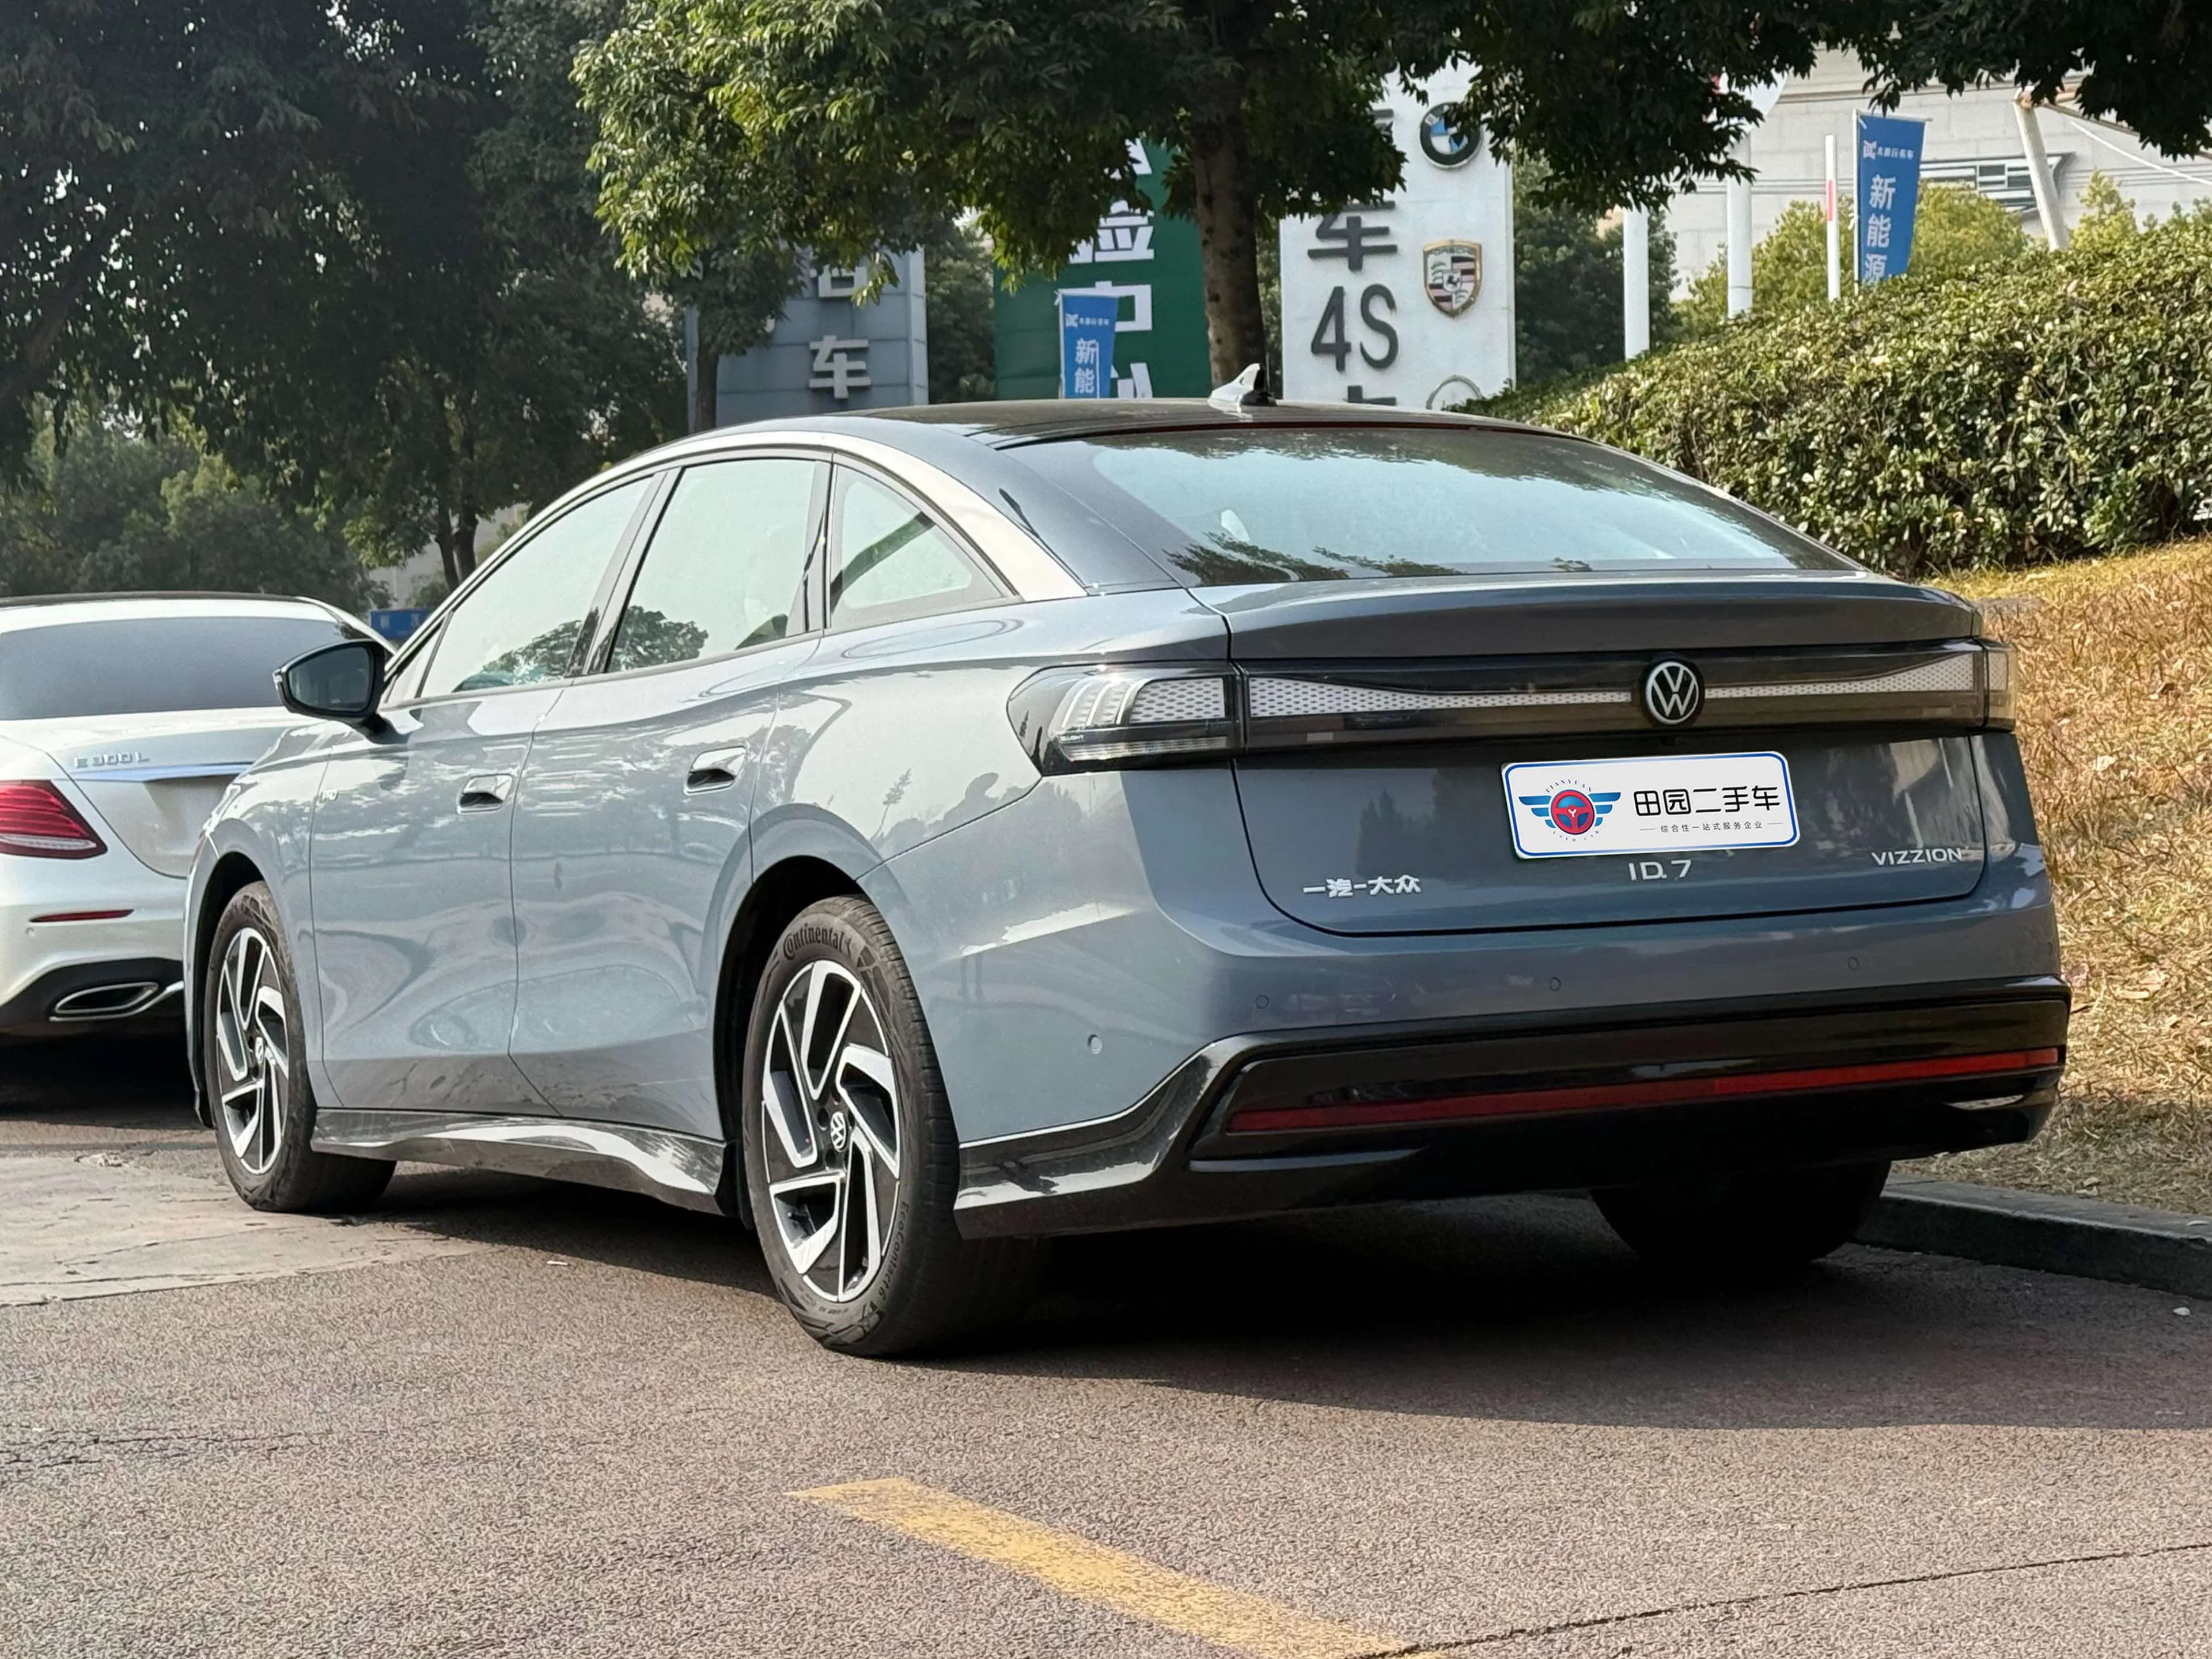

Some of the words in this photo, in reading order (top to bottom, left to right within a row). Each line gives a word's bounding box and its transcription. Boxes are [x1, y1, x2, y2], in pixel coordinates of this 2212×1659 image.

[1871, 847, 1963, 866] VIZZION
[1628, 859, 1691, 881] ID.7
[1303, 874, 1422, 898] 一汽-大众
[783, 922, 844, 960] Continental
